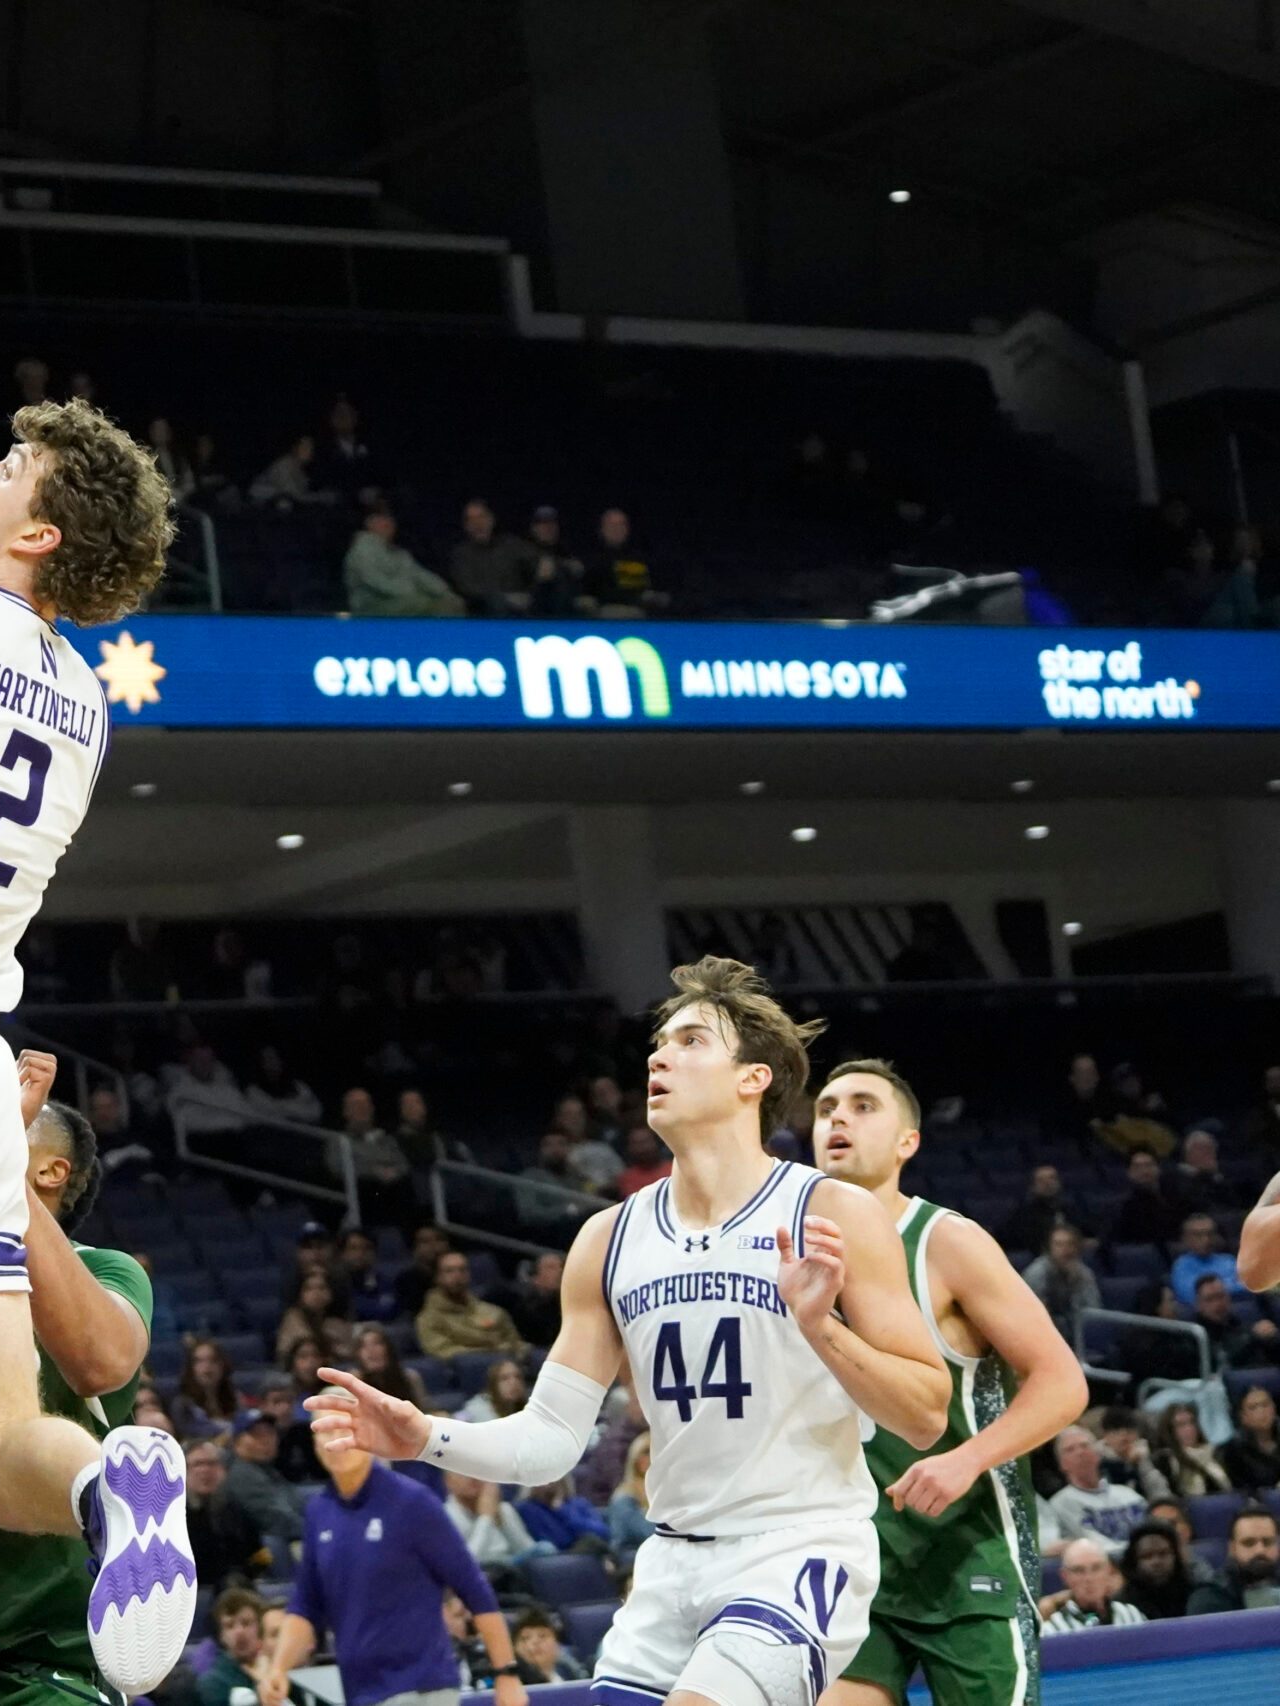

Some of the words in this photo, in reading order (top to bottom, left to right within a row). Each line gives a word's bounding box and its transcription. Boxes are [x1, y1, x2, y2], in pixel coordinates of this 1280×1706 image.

[40, 632, 58, 680] N
[1038, 643, 1106, 682] star
[1106, 641, 1142, 682] of
[1042, 678, 1101, 719] the
[1102, 677, 1194, 719] north
[617, 1271, 788, 1327] NORTHWESTERN
[653, 1317, 752, 1423] 44
[794, 1558, 848, 1637] N
